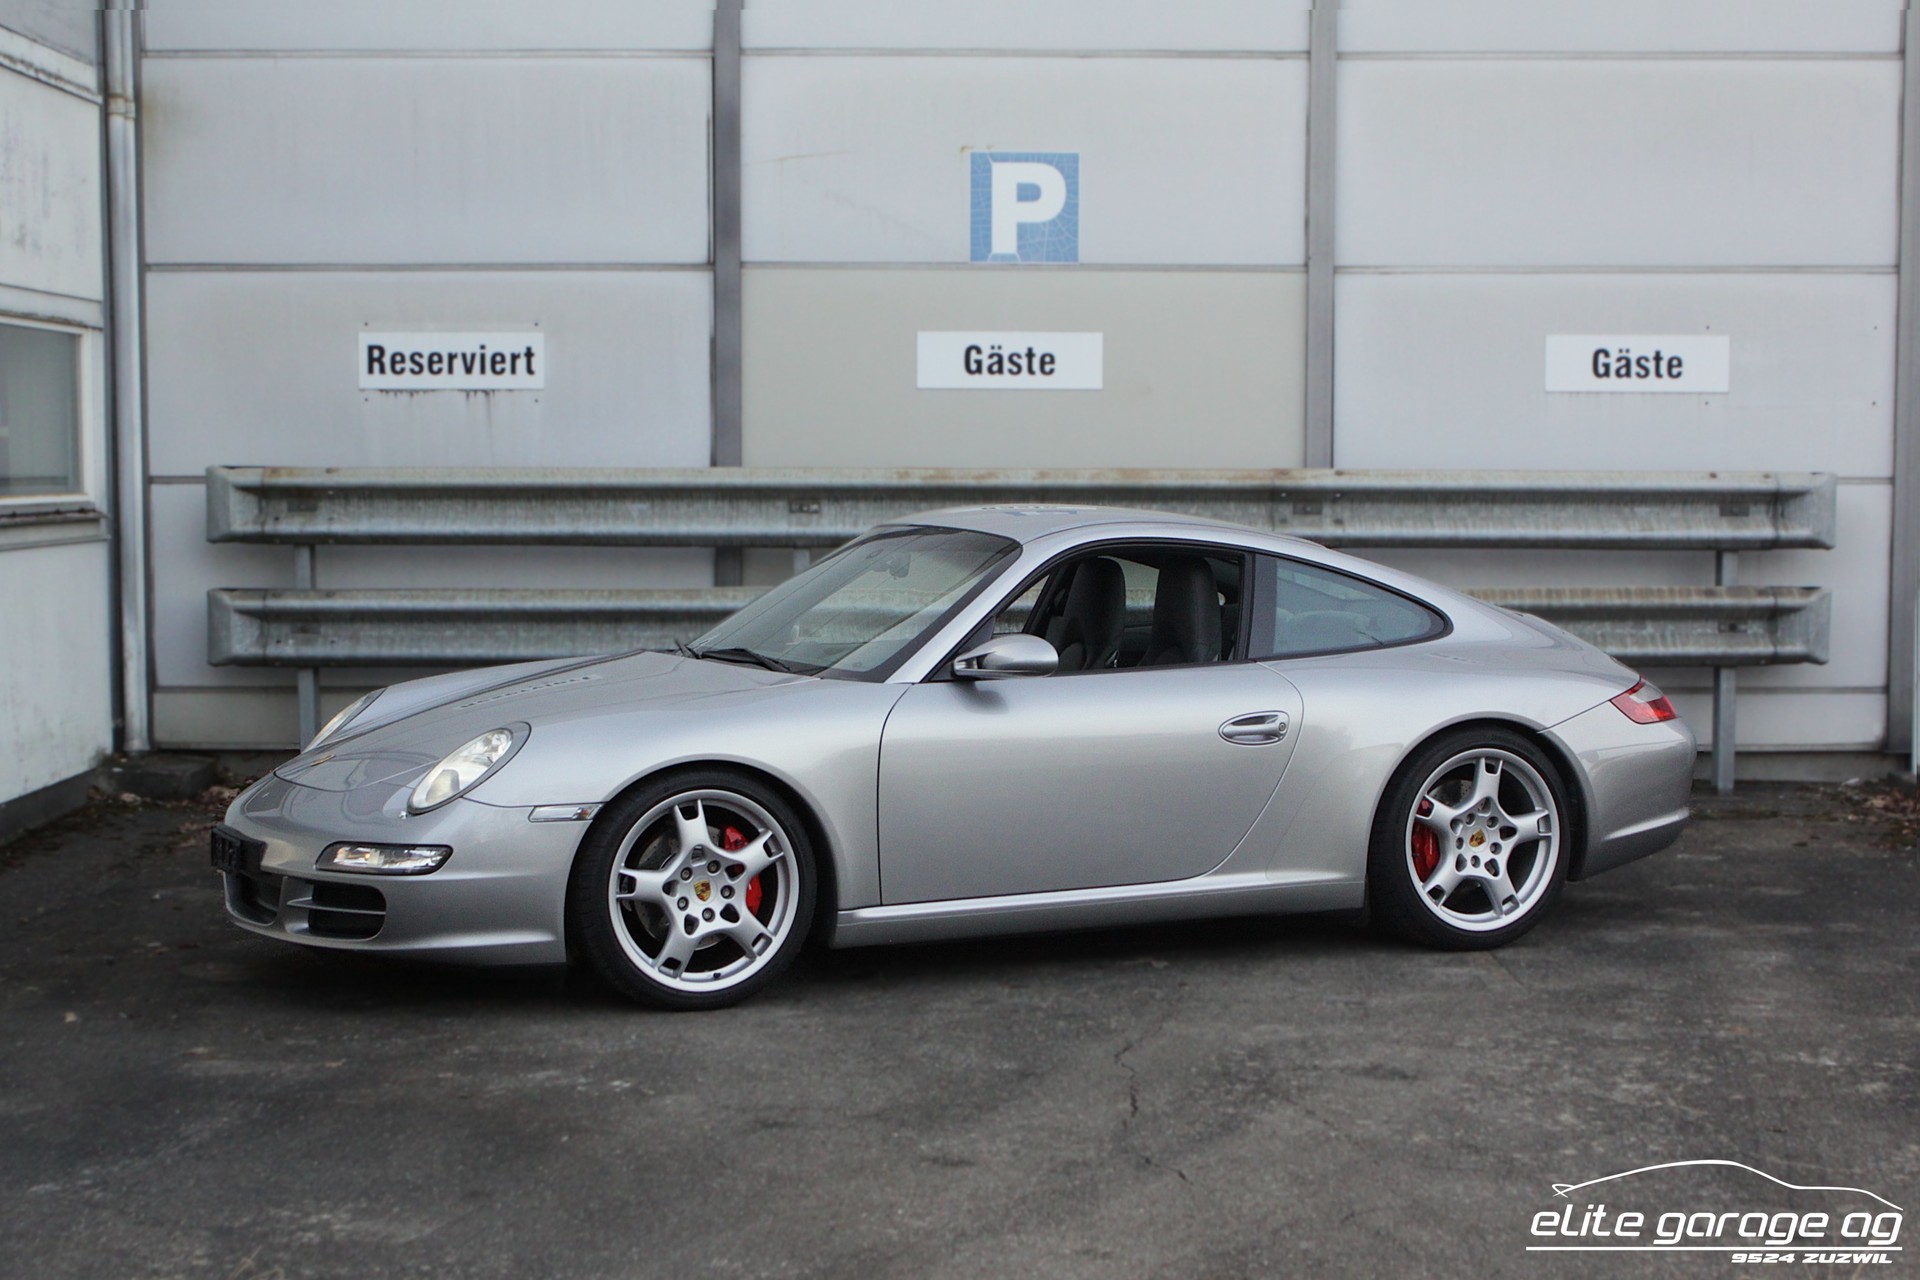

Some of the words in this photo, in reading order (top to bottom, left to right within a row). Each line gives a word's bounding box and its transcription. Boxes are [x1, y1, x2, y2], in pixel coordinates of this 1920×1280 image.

[992, 162, 1067, 254] P
[367, 344, 535, 376] Reserviert
[964, 345, 1056, 376] Gäste
[1592, 348, 1684, 379] Gäste
